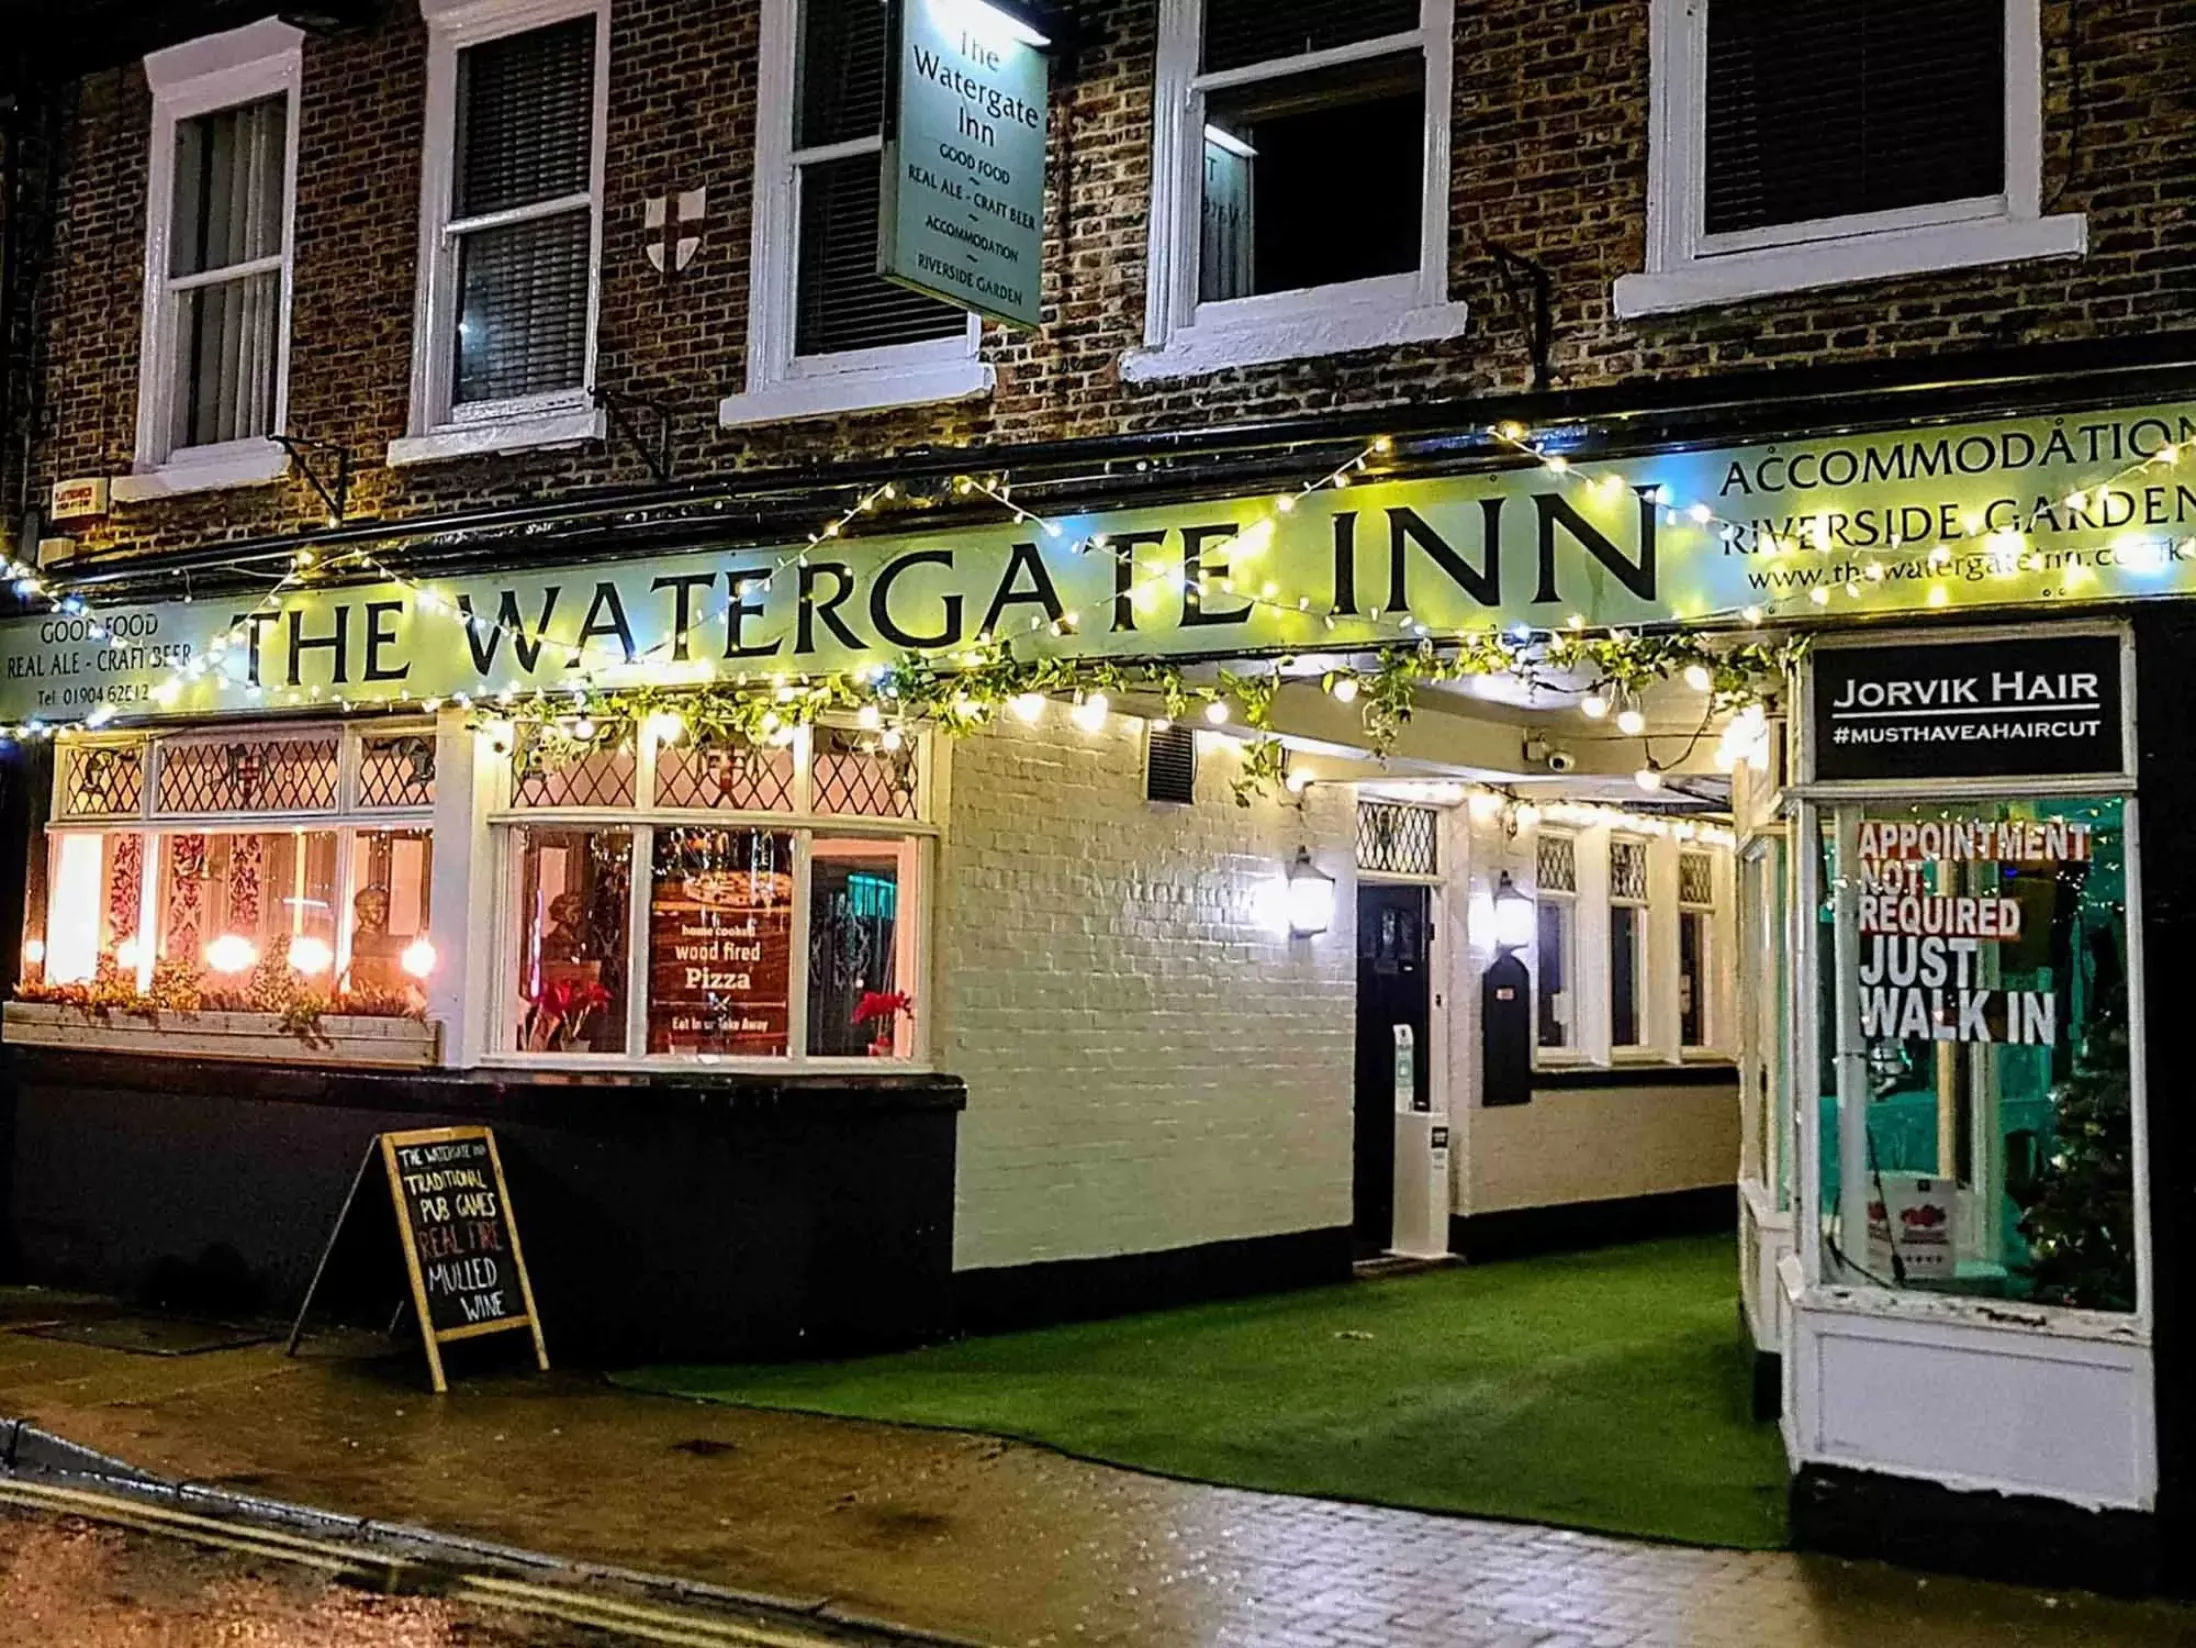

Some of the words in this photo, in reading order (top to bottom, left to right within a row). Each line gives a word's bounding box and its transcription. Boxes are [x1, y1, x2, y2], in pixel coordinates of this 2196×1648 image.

[960, 29, 1000, 72] The
[913, 44, 1039, 128] Watergate
[957, 107, 995, 147] Inn
[939, 143, 976, 171] GOOD
[977, 158, 1010, 185] FOOD
[908, 163, 938, 190] REAL
[940, 177, 963, 201] ALE
[973, 192, 1007, 221] CRAFT
[1010, 203, 1036, 231] BEER
[925, 214, 1019, 263] ACCOMMODATION
[918, 253, 973, 288] RIVERSIDE
[976, 274, 1022, 306] GARDEN
[1722, 504, 1963, 556] RIVERSIDE
[231, 600, 412, 688] THE
[456, 523, 1255, 677] WATERGATE
[1331, 483, 1662, 616] INN
[41, 620, 97, 644] GOOD
[105, 613, 159, 638] FOOD
[8, 655, 44, 680] REAL
[50, 651, 80, 675] ALE
[97, 646, 145, 672] CRAFT
[63, 686, 104, 705] 01904
[1833, 677, 1979, 708] JORVIK
[1991, 671, 2099, 702] HAIR
[1832, 720, 2101, 745] #MUSTHAVEAHAIRCUT
[1859, 822, 2091, 861] APPOINTMENT
[1859, 859, 1924, 896] NOT
[1859, 896, 2021, 936] REQUIRED
[675, 941, 718, 961] wood
[723, 941, 760, 961] fired
[1859, 934, 1977, 989] JUST
[685, 967, 751, 989] Pizza
[1860, 985, 1992, 1042] WALK
[2007, 990, 2056, 1048] IN
[404, 1169, 488, 1196] TRADITIONAL
[420, 1196, 450, 1222] PUB
[428, 1257, 498, 1296] MULLED
[460, 1290, 506, 1322] WINE
